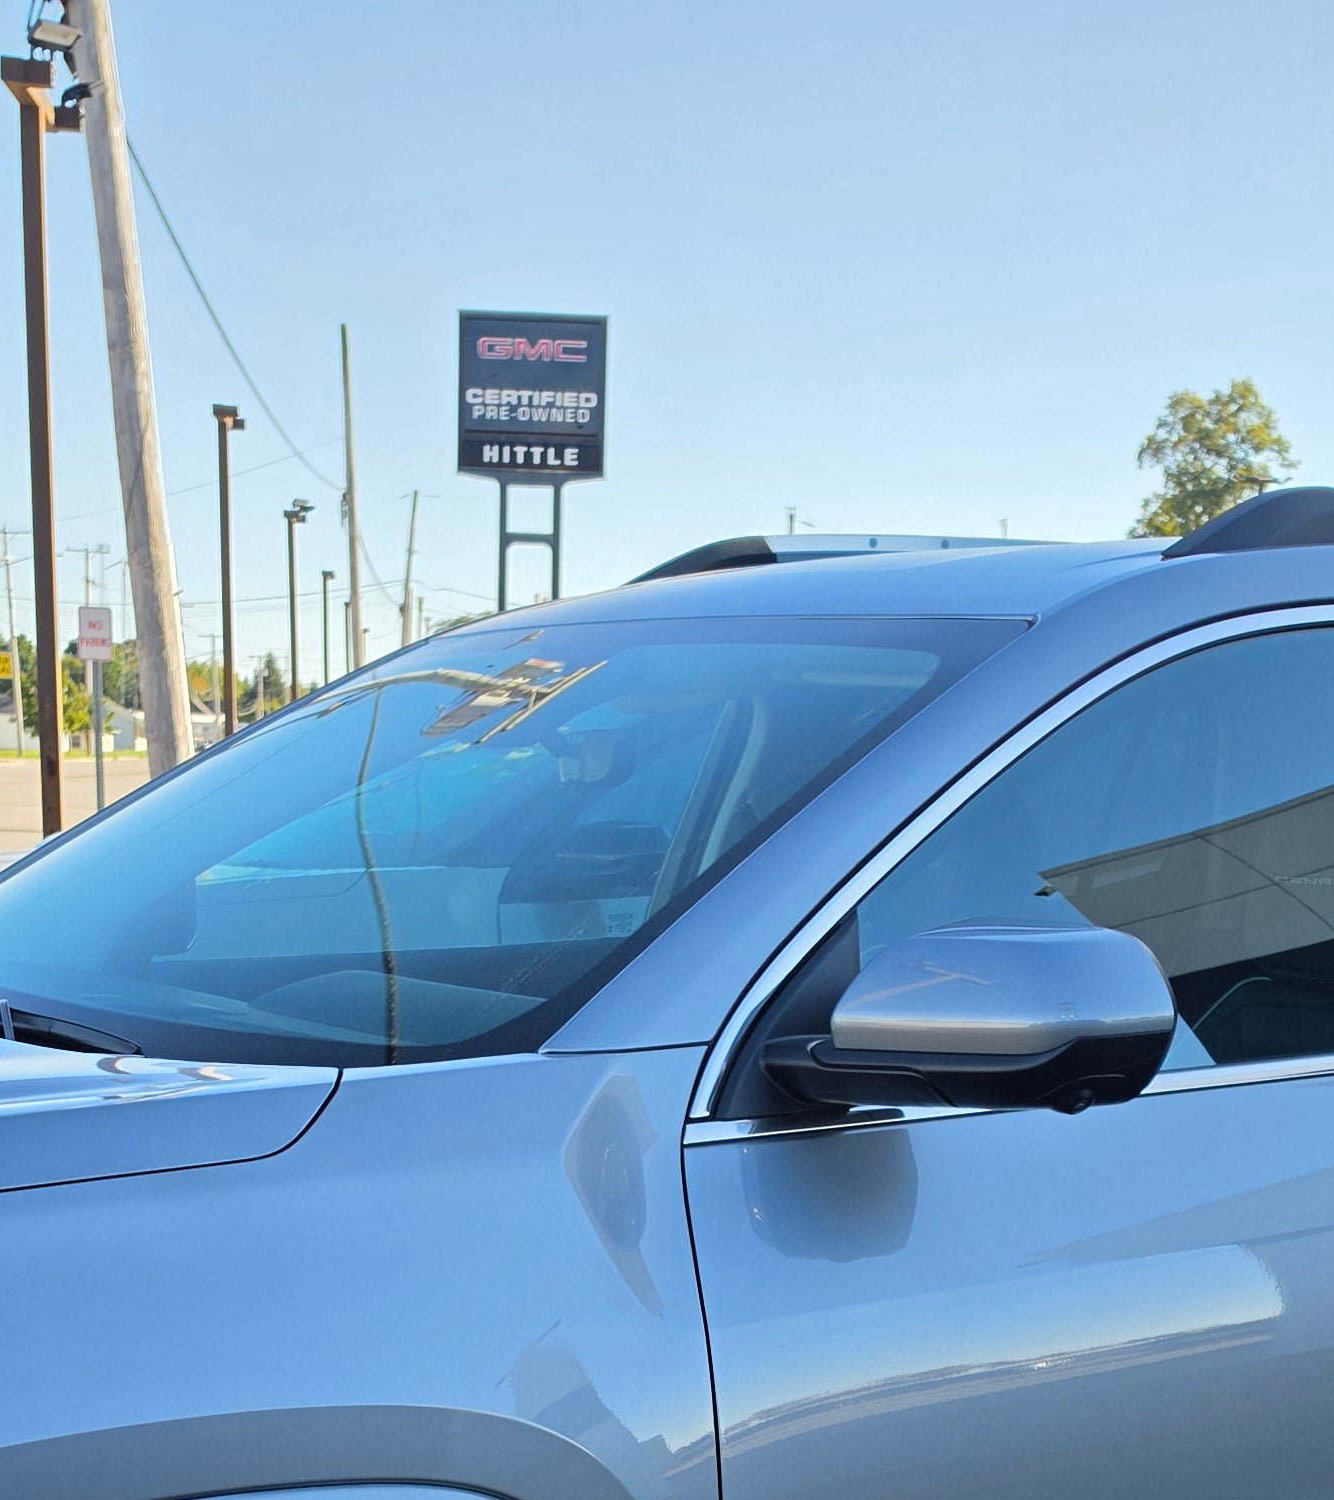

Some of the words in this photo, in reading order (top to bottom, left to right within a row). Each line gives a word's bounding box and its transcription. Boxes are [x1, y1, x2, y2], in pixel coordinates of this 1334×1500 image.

[477, 336, 588, 363] GMC
[465, 388, 598, 408] CERTIFIED
[472, 405, 591, 423] PRE-OWNED
[482, 444, 580, 466] HITTLE
[86, 619, 103, 631] NO
